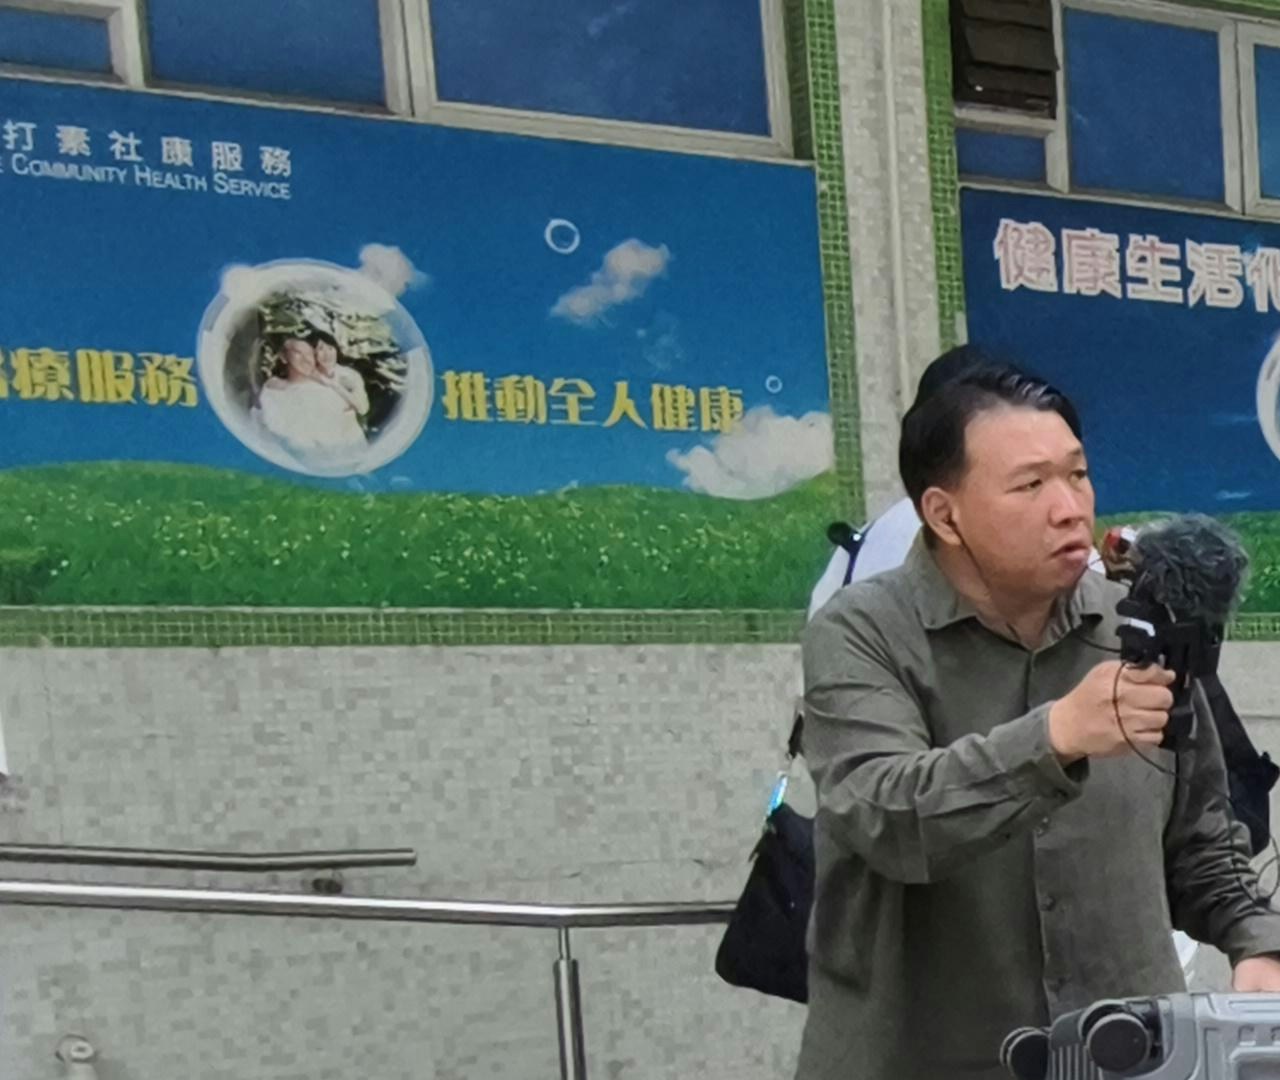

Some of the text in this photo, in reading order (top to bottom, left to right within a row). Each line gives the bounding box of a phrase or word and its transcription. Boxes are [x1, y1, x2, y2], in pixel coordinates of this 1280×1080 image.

[0, 347, 744, 433] 療服務 推動全人健康
